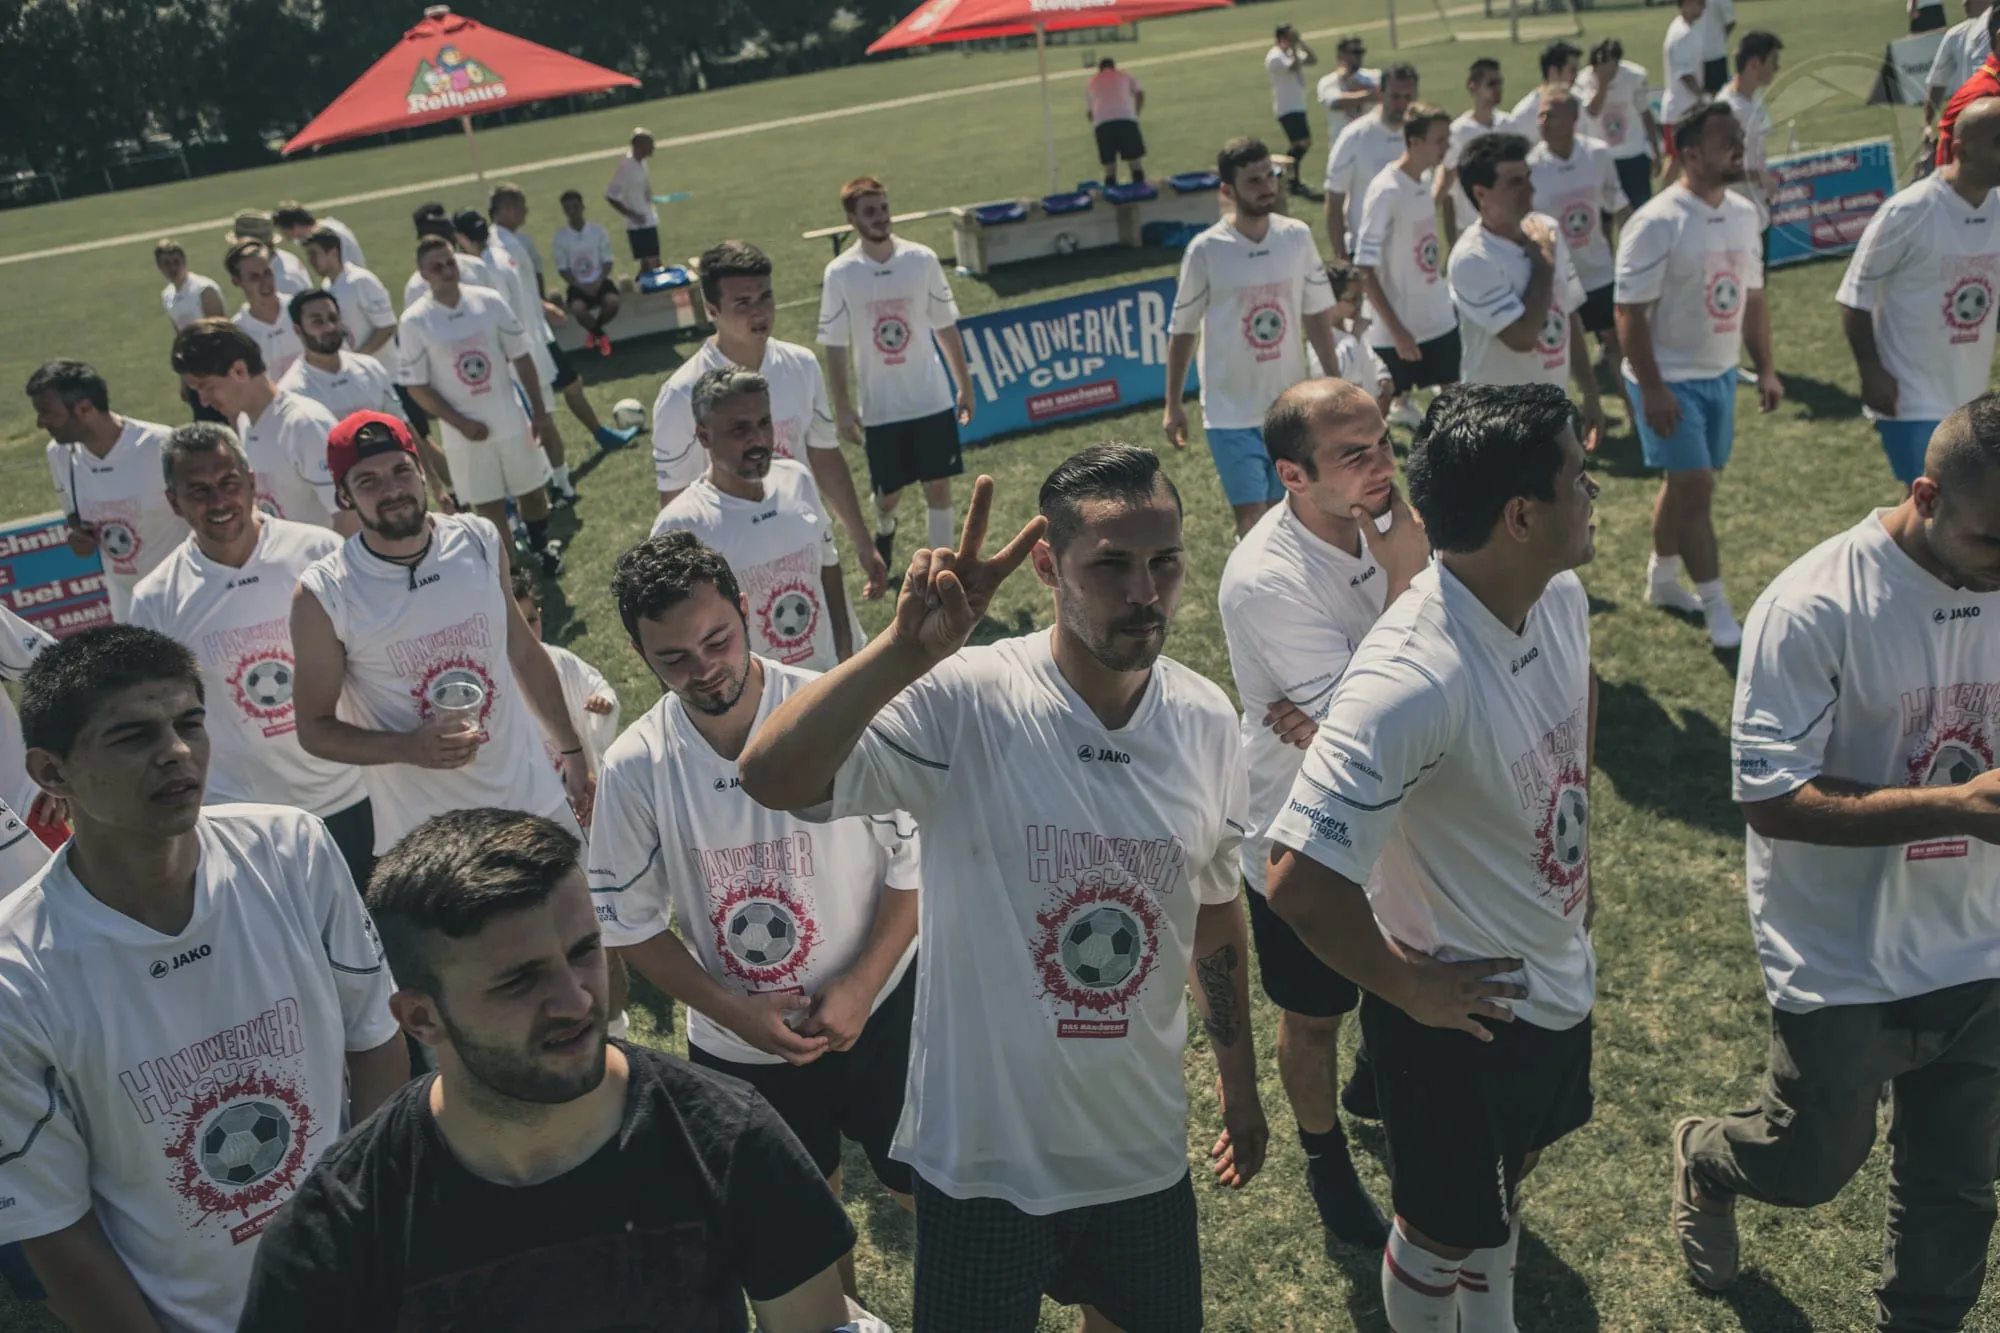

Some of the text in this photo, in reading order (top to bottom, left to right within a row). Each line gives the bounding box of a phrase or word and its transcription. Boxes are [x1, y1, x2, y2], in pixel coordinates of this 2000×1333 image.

[962, 291, 1168, 403] HANDWERKER
[1029, 358, 1105, 388] CUP
[11, 580, 65, 608] bei
[419, 574, 440, 587] JAKO
[1949, 606, 1981, 620] JAKO
[1520, 646, 1539, 669] JAKO
[1098, 749, 1131, 764] JAKO
[1289, 798, 1349, 836] handwerk
[1311, 821, 1353, 849] magazin
[1027, 824, 1188, 894] HANDWERKER
[730, 869, 781, 889] CUP
[172, 944, 212, 969] JAKO
[119, 997, 304, 1124] HANDWERKER
[195, 1060, 263, 1099] CUP
[236, 1224, 254, 1237] DAS
